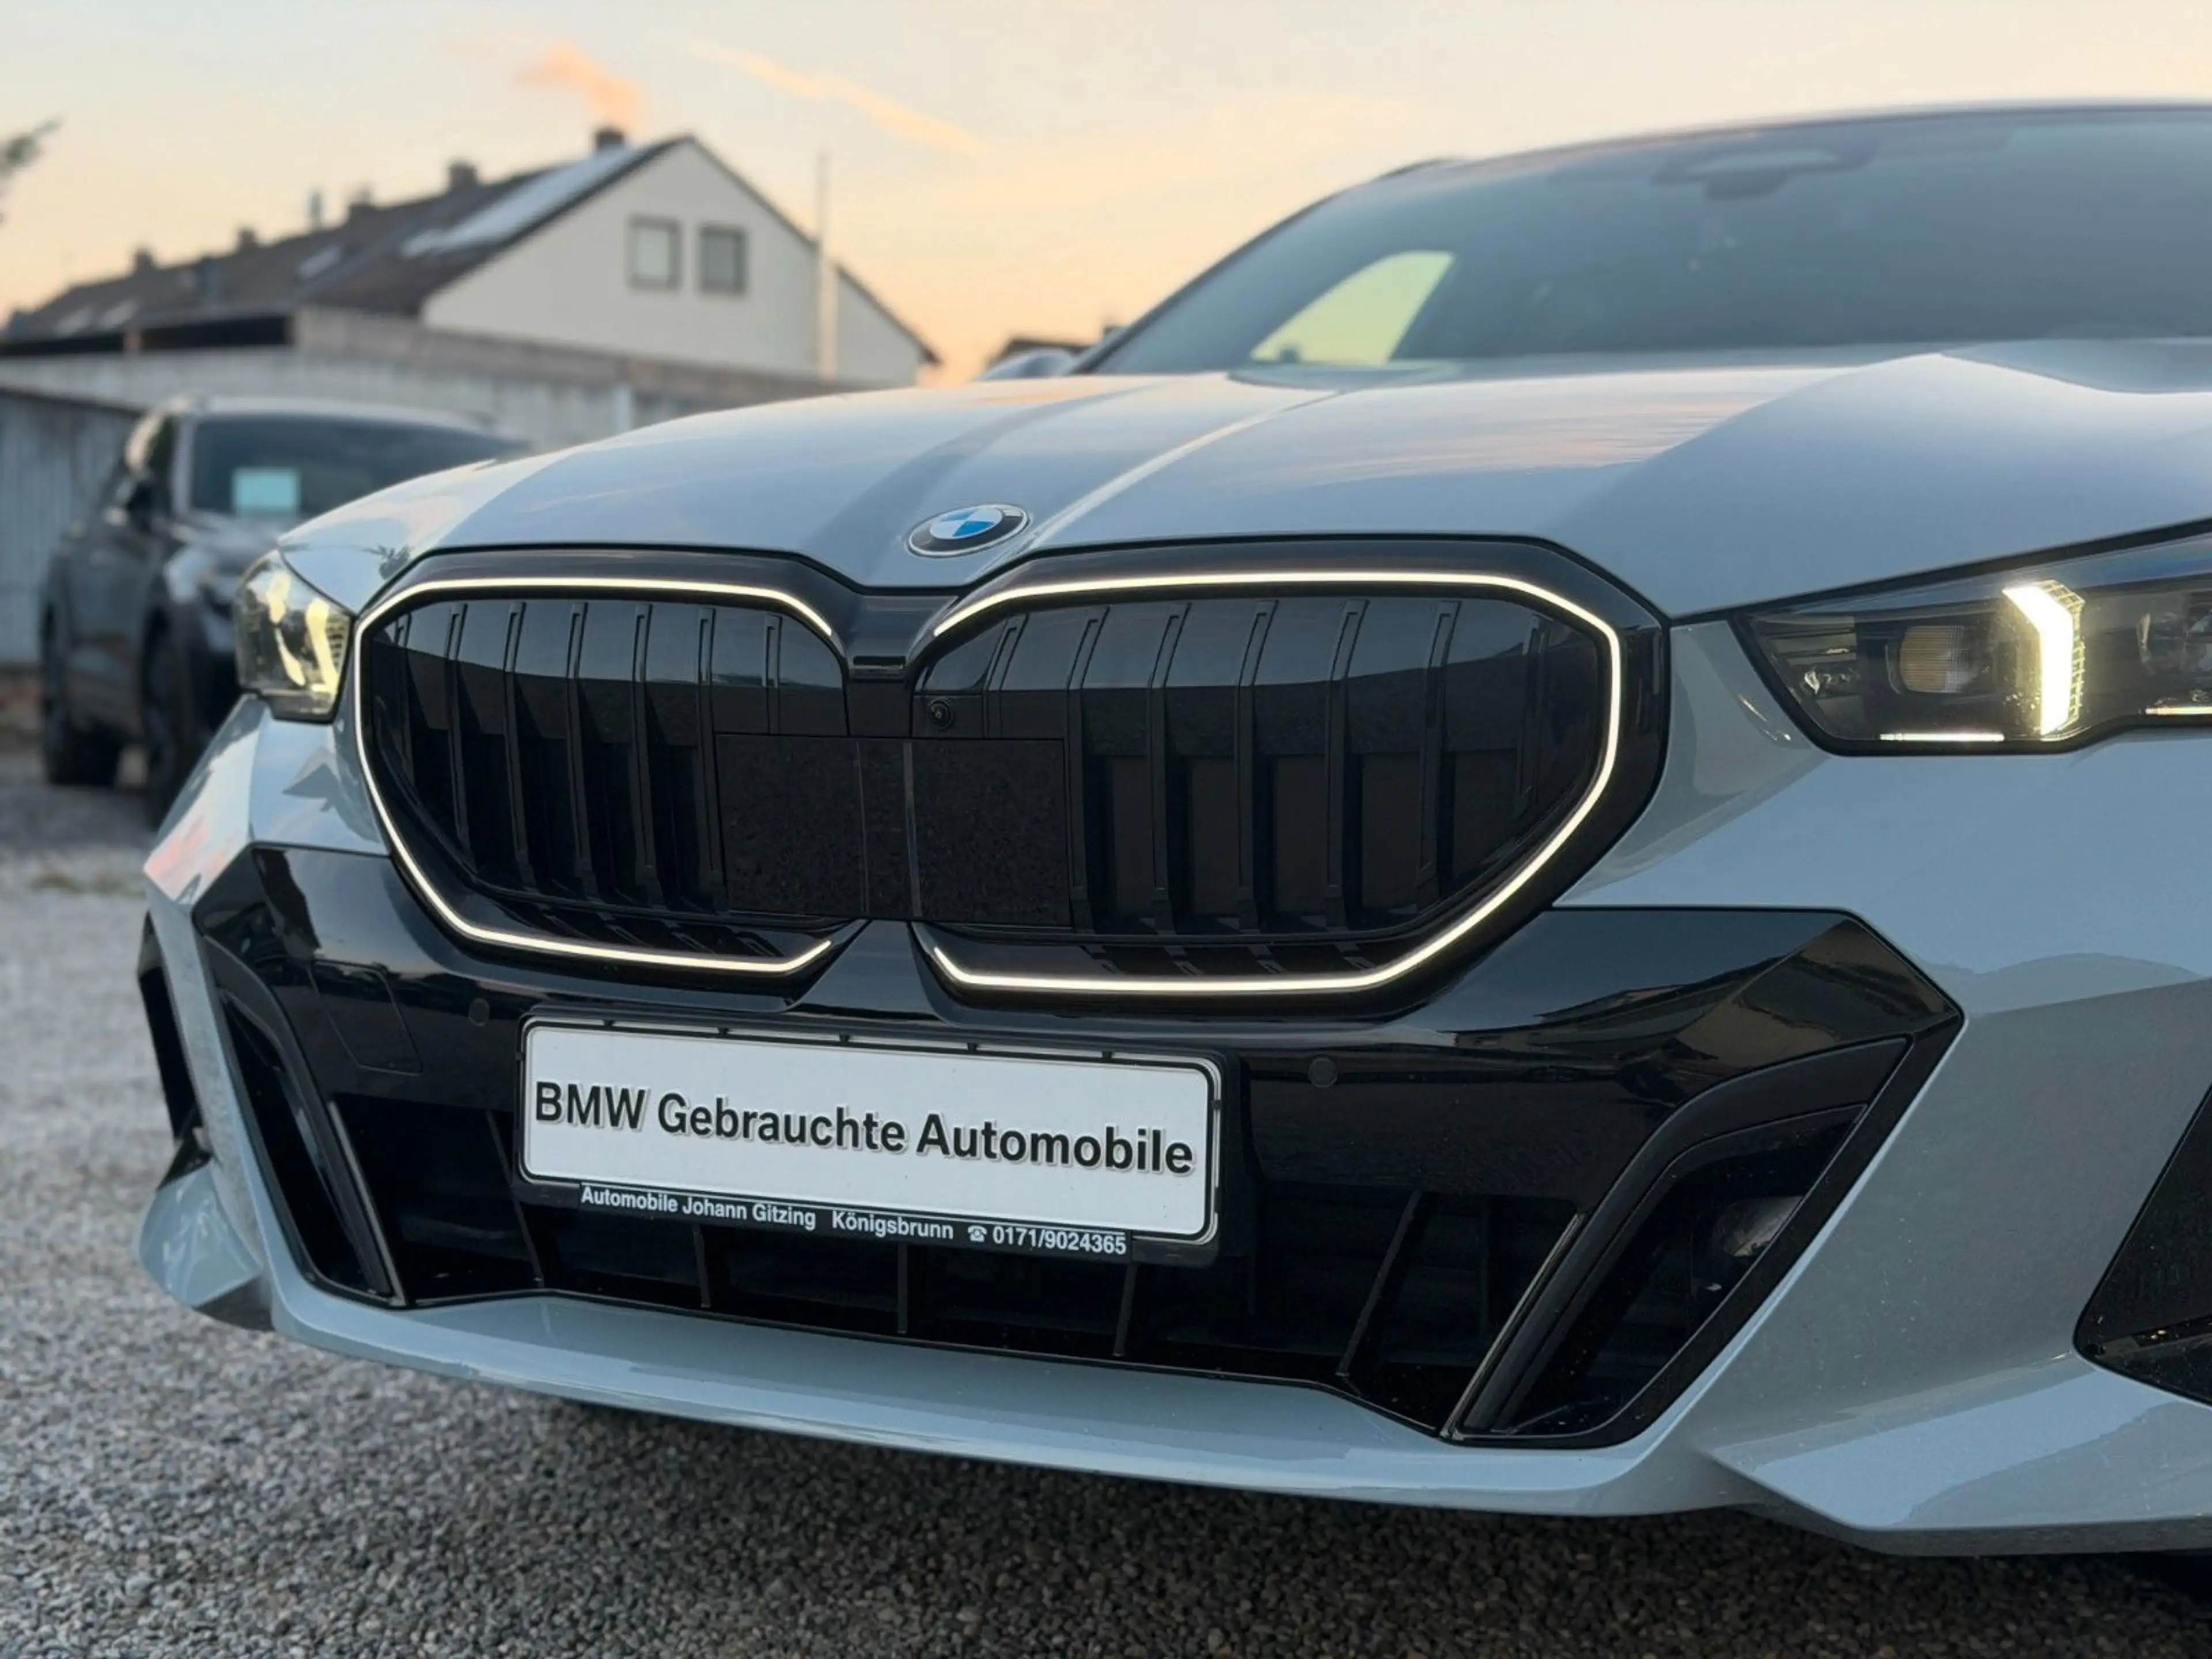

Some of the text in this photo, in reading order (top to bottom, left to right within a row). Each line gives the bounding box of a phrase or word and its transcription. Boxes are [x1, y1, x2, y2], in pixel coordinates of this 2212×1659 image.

[536, 1081, 1194, 1174] BMW Gebrauchte Automobile
[581, 1185, 1127, 1255] Automobile Johann Gitzing Königsbrunn 0171/9024365
